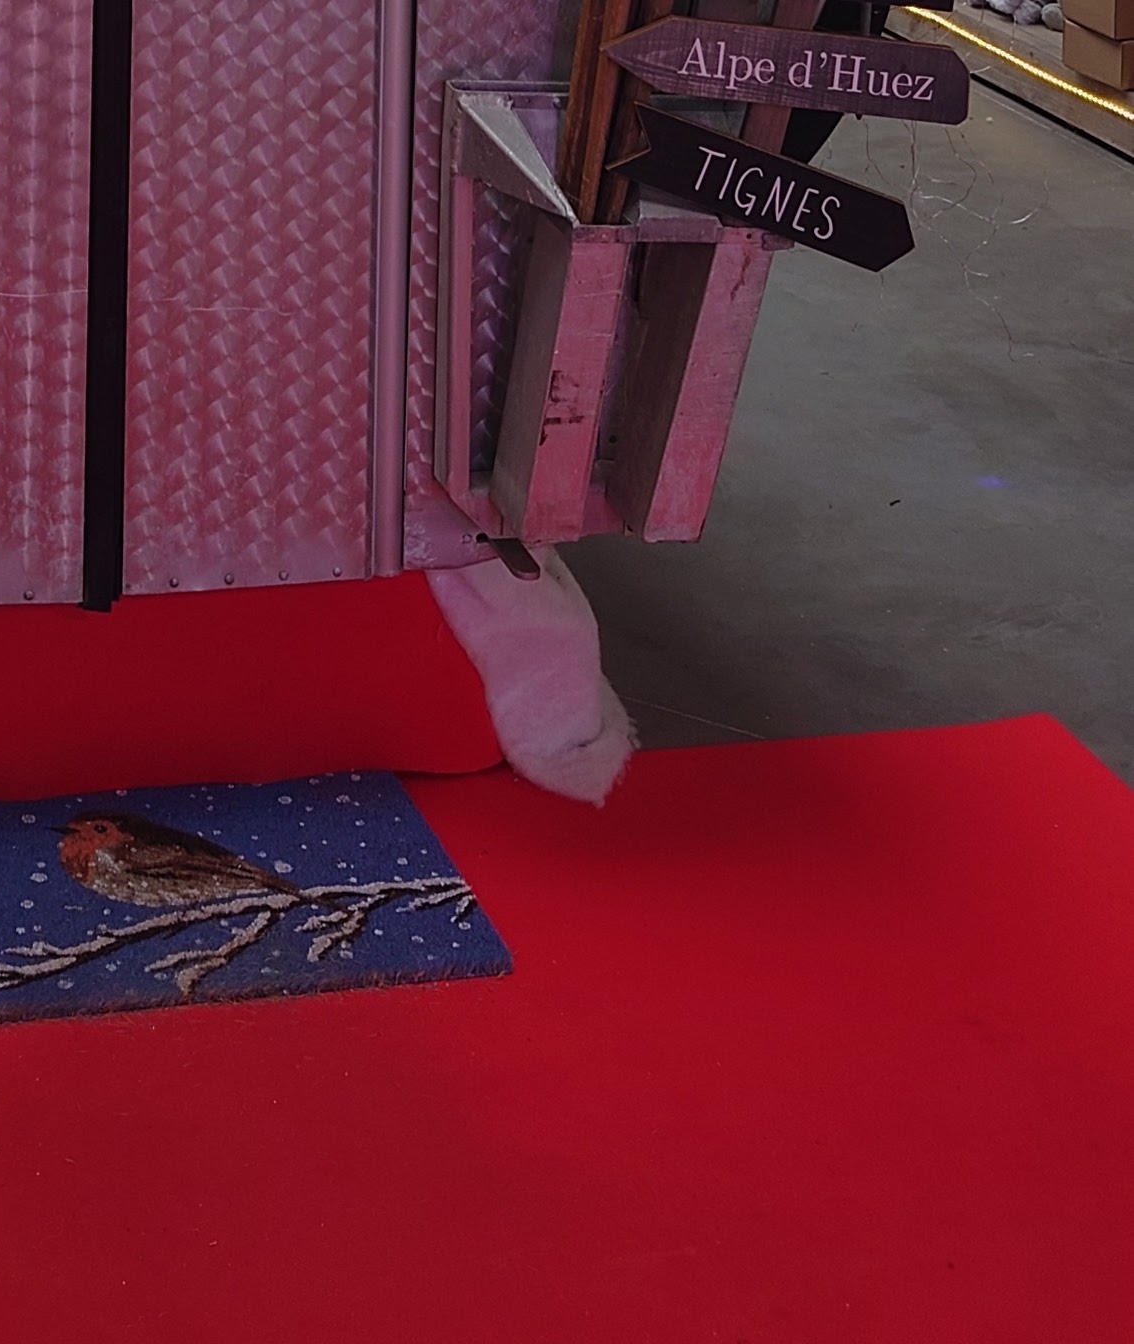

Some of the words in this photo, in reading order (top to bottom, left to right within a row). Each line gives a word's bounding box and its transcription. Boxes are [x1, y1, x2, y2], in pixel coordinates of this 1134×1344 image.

[676, 37, 776, 92] Alpe
[788, 50, 936, 102] d'Huez
[693, 145, 842, 242] TIGNES
